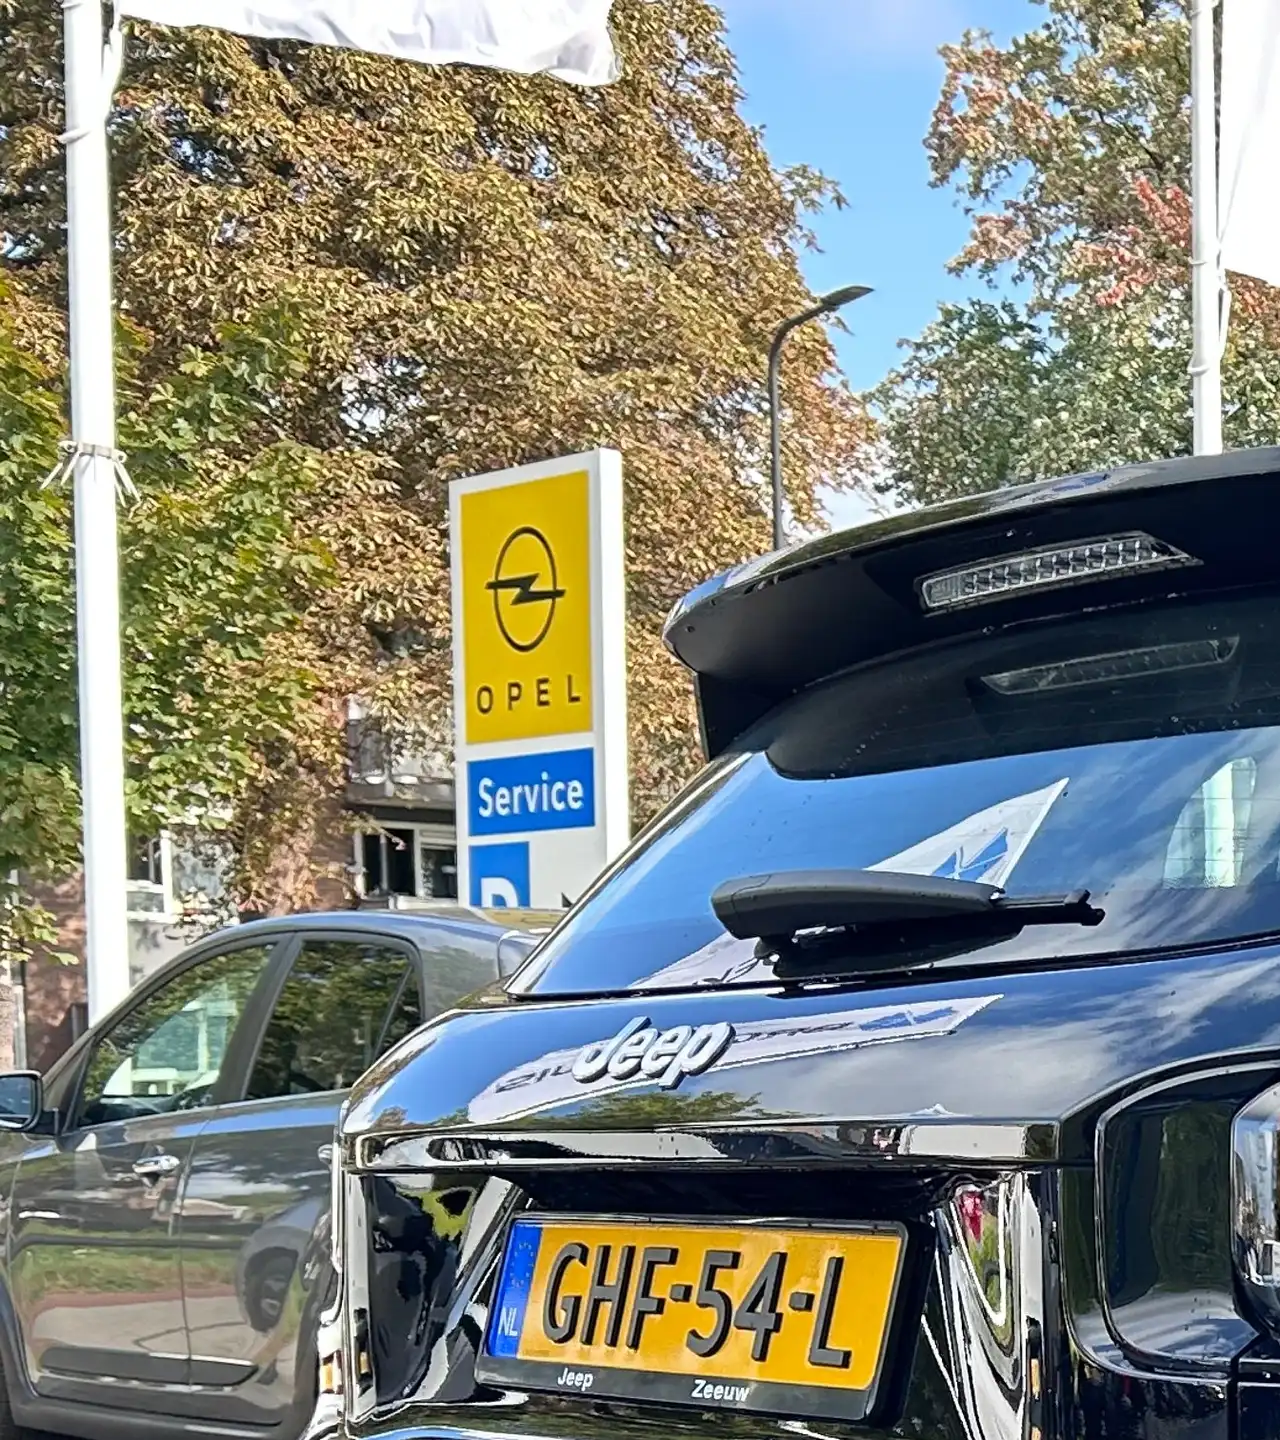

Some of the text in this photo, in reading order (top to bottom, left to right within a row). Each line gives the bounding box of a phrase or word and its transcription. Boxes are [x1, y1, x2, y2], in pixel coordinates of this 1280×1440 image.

[476, 674, 581, 715] OPEL
[478, 771, 585, 818] Service
[570, 1015, 736, 1090] Jeep
[499, 1306, 519, 1338] NL
[541, 1242, 853, 1370] GHF-54-L
[557, 1367, 751, 1402] Jeep Zeeuw
